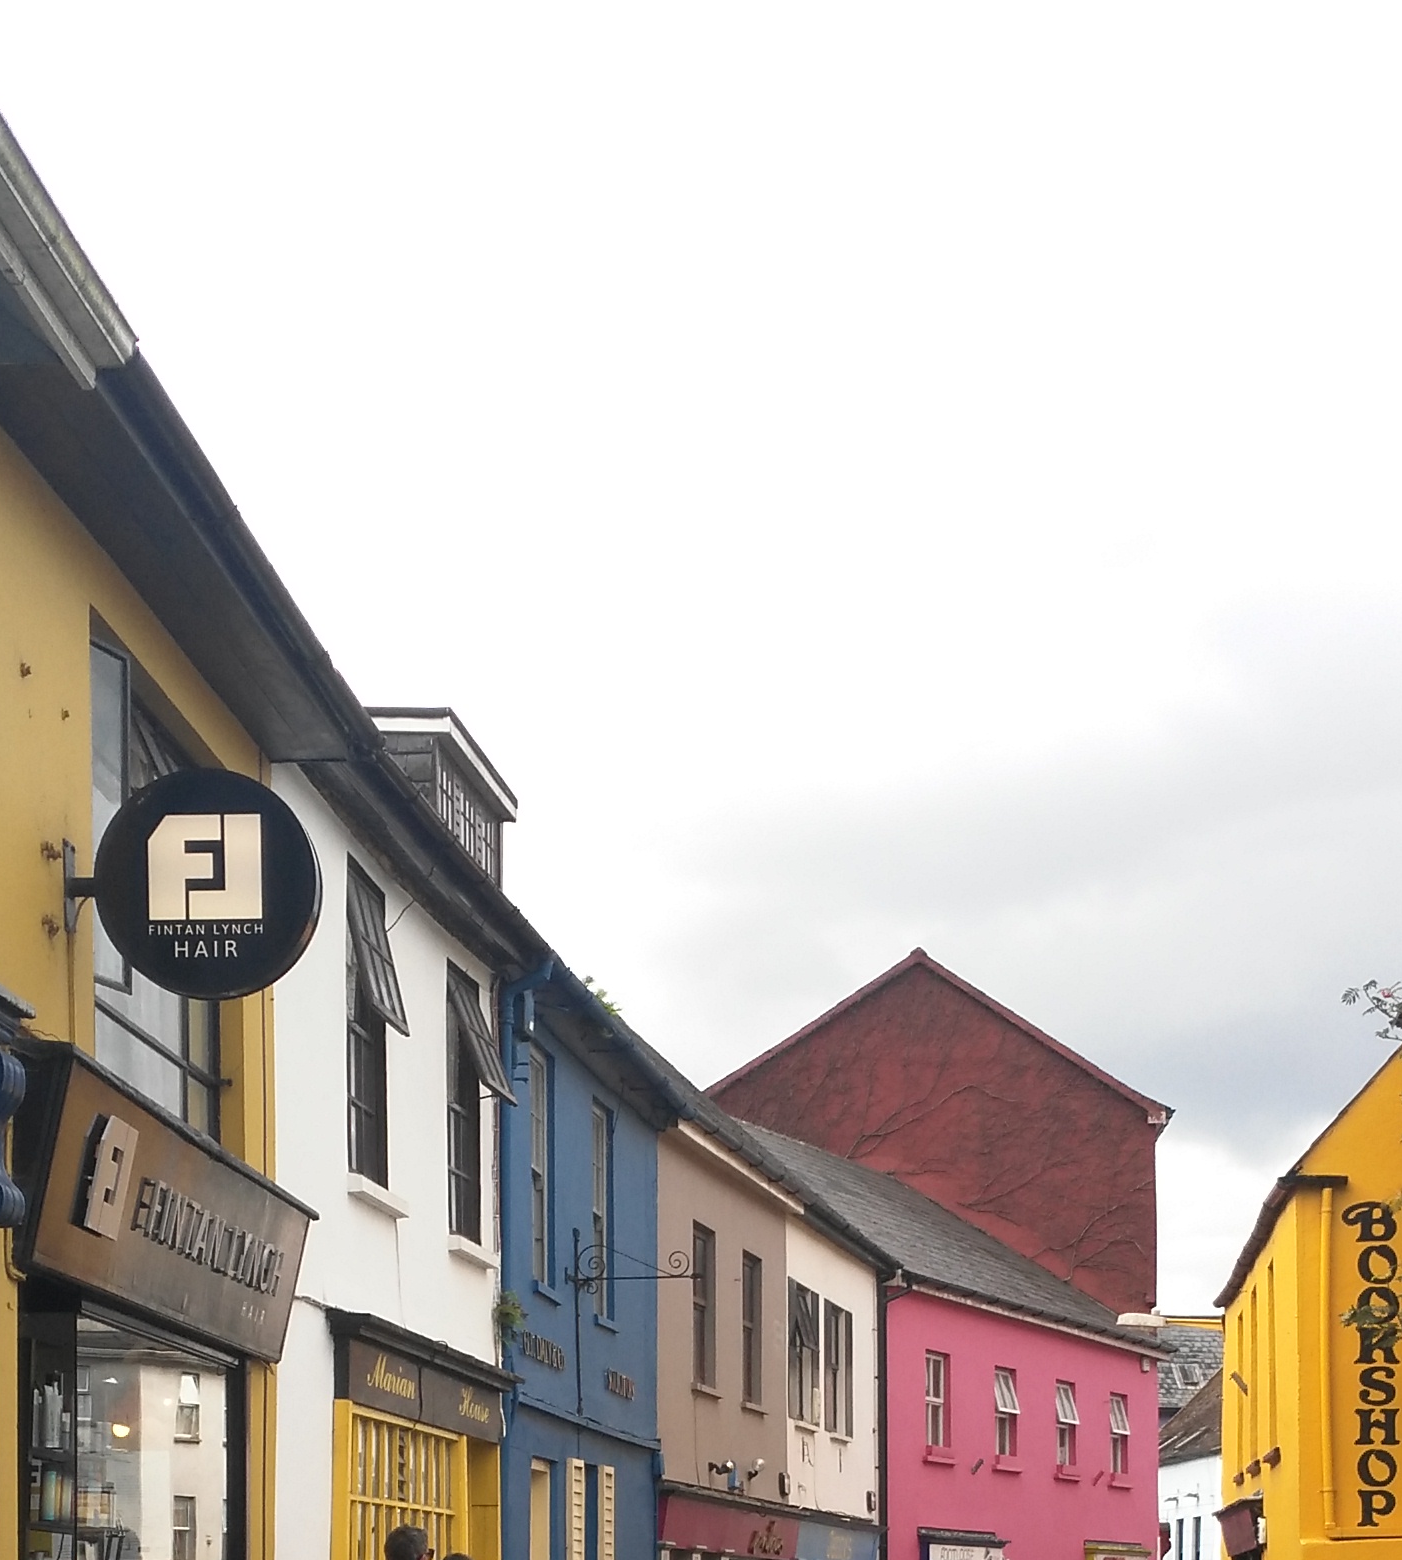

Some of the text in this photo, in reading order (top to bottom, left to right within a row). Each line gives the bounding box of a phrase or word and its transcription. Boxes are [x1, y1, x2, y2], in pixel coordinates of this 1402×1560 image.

[148, 923, 264, 936] FINTAN LYNCH
[174, 940, 238, 958] HAIR
[143, 1179, 285, 1297] FINTAN LYNCH
[240, 1301, 267, 1325] HAIR
[1342, 1201, 1401, 1527] BOOKSHOP
[367, 1353, 491, 1424] Marian House
